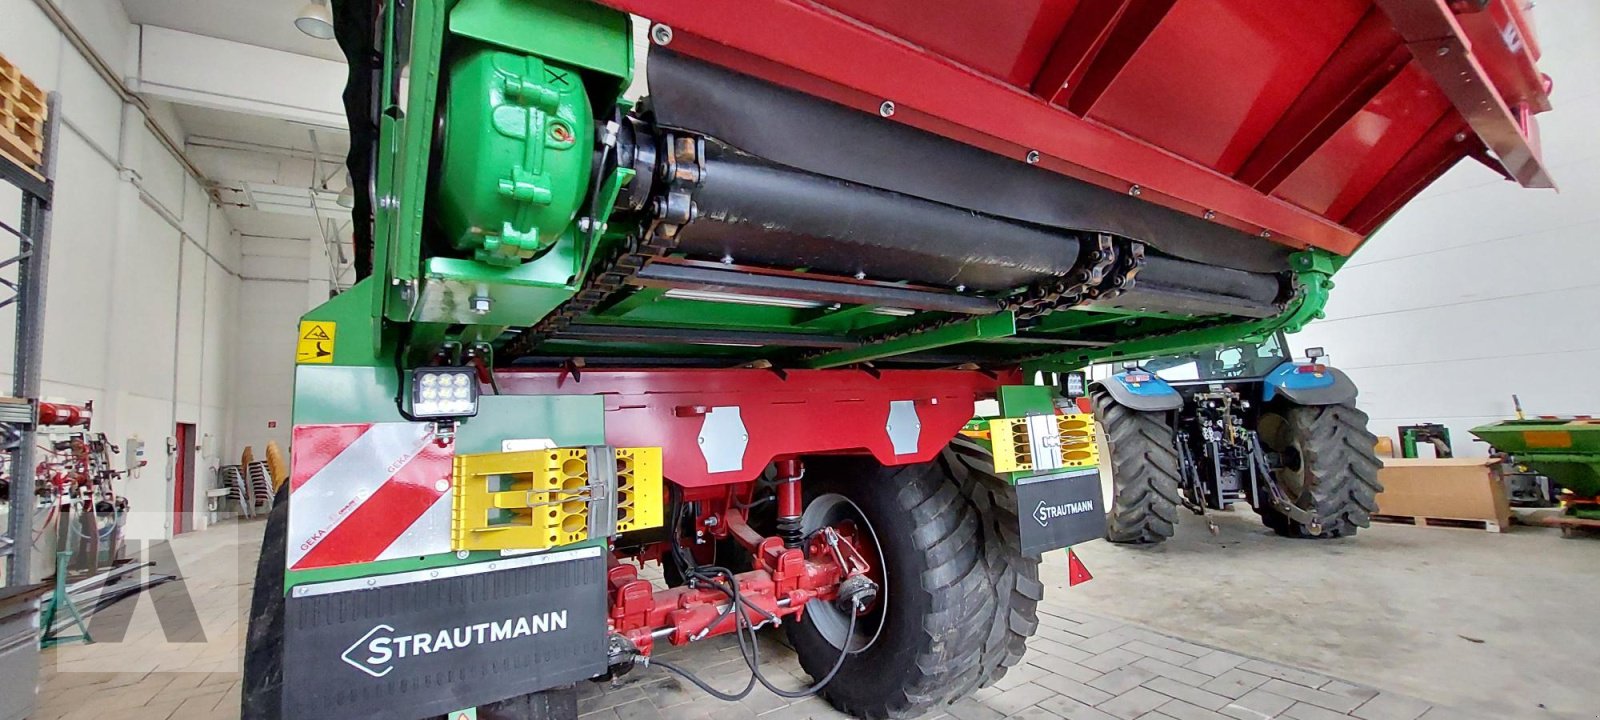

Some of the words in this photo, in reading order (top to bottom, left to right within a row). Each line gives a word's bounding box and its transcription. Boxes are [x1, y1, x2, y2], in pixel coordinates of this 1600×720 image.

[387, 454, 411, 473] GEKA
[1039, 500, 1093, 521] STRAUTMANN
[300, 529, 327, 551] GEKA
[366, 610, 567, 664] STRAUTMANN
